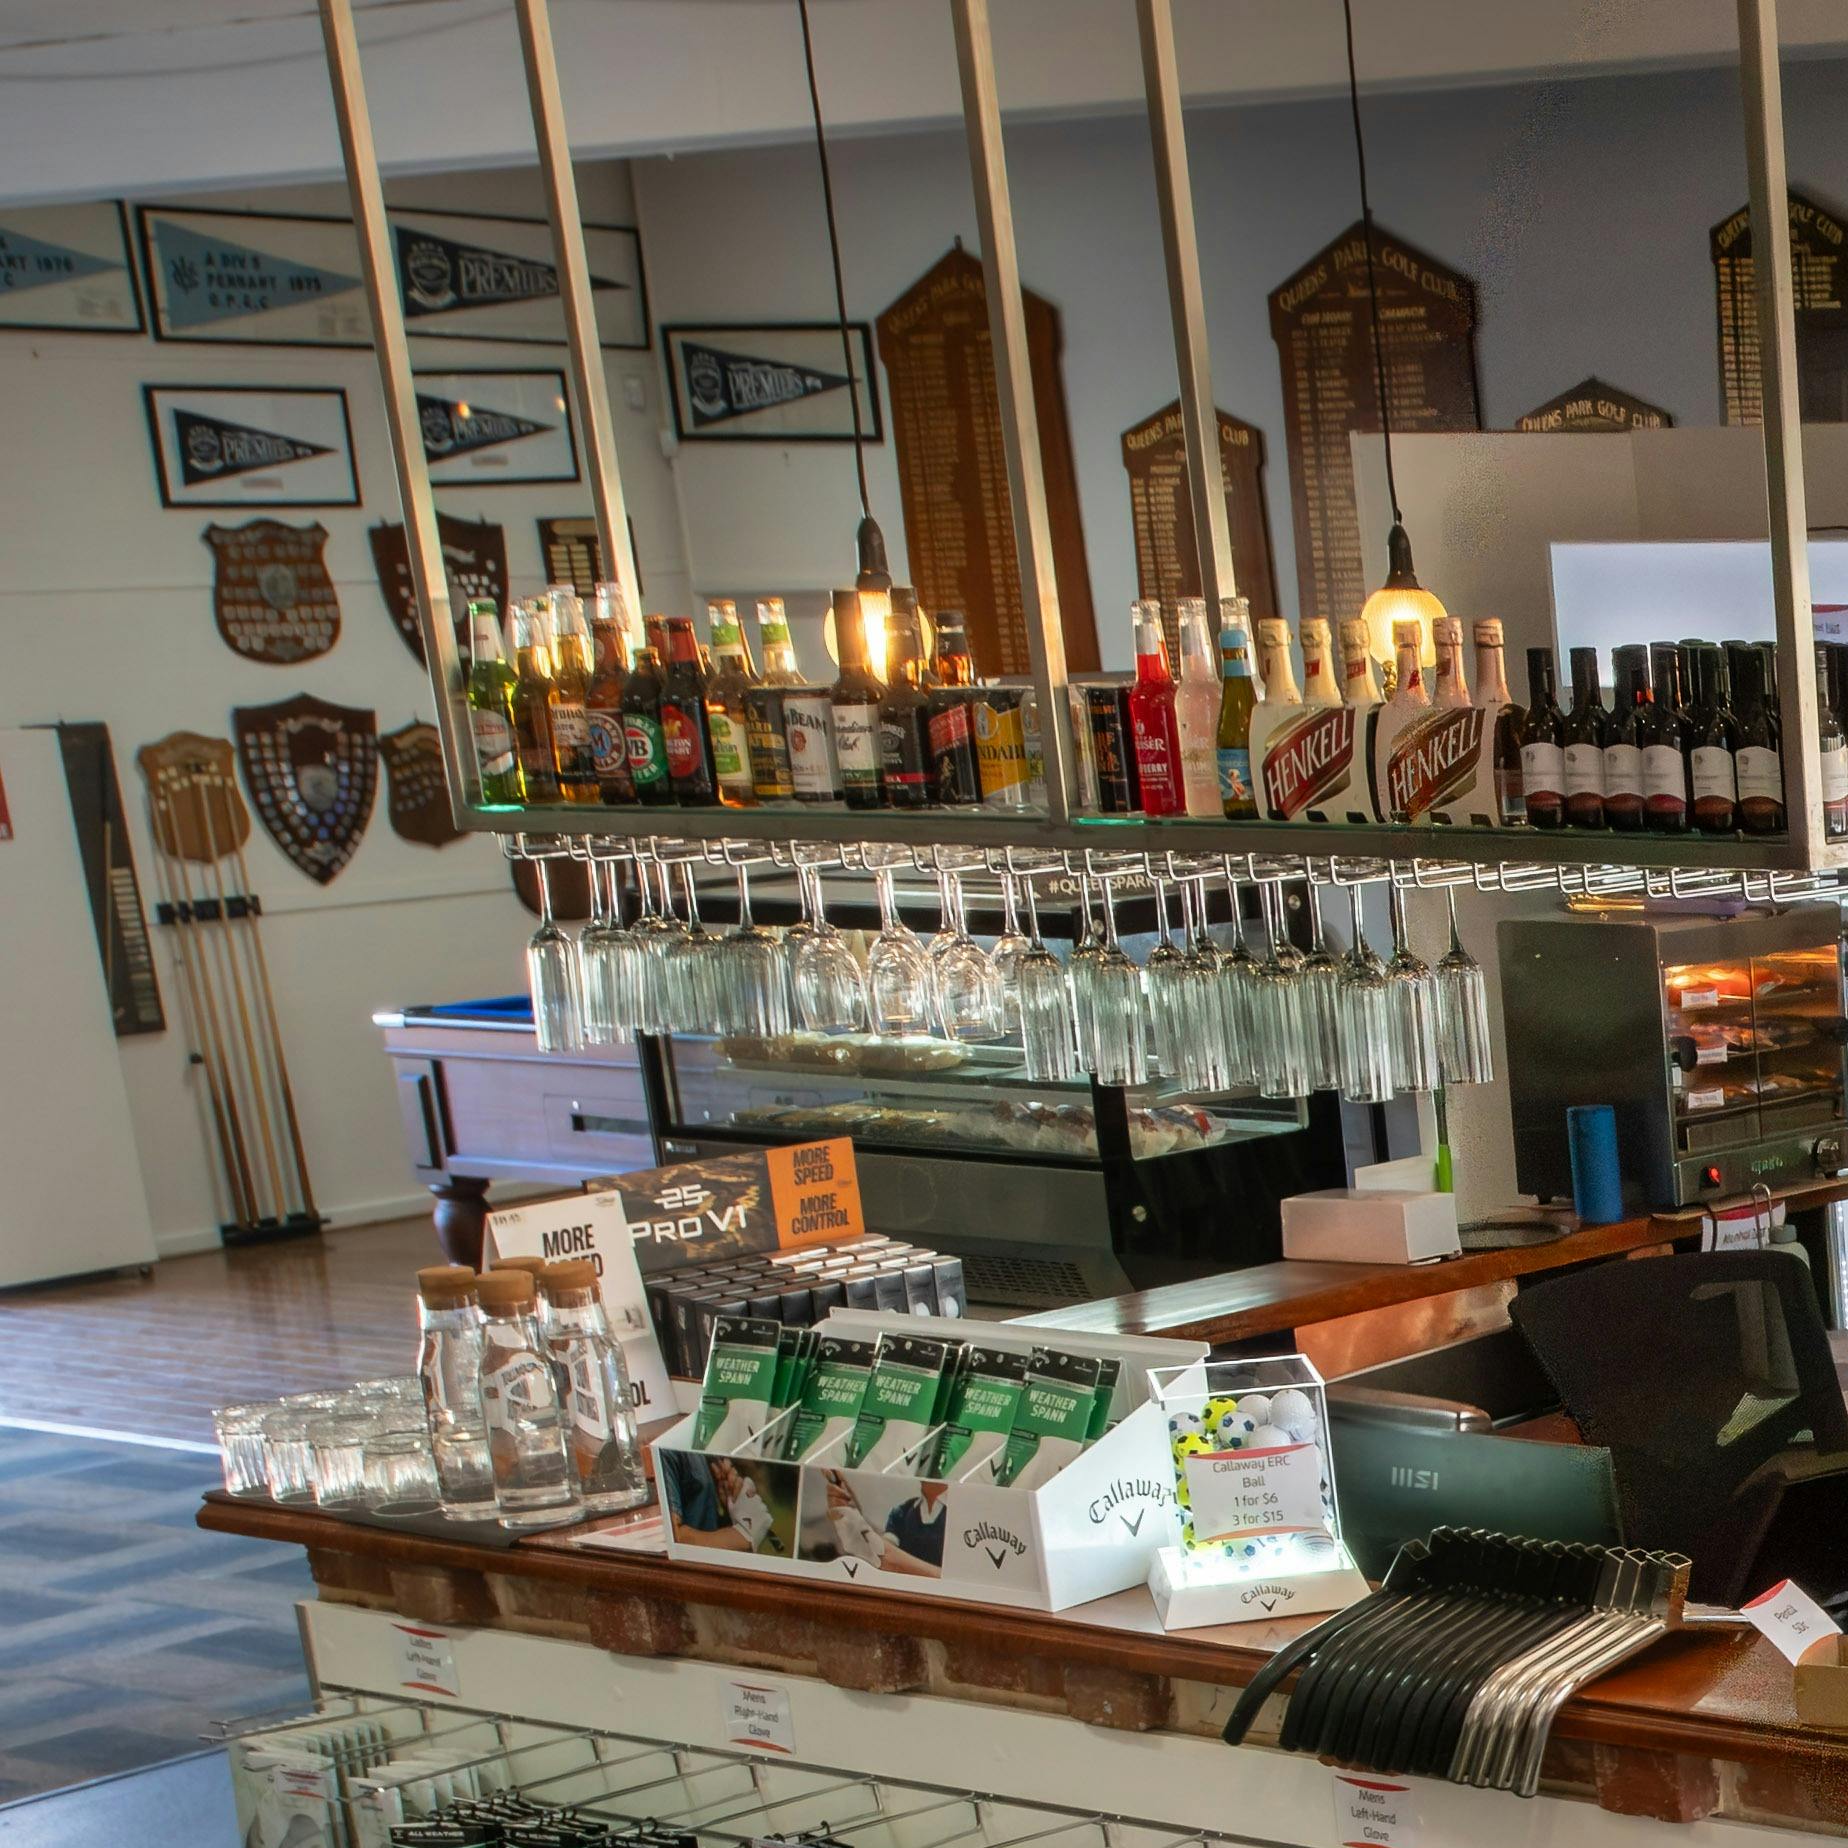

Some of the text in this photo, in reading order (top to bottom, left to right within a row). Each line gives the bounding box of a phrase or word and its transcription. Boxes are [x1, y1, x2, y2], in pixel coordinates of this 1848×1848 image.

[1381, 246, 1418, 283] GOLF
[1421, 271, 1459, 301] CLUB
[1566, 399, 1594, 418] PARK
[1597, 400, 1626, 424] GOLF
[1222, 425, 1249, 446] CLUB
[1266, 706, 1352, 811] HENKELL
[1394, 708, 1482, 812] HENKELL
[792, 1146, 830, 1167] MORE
[793, 1162, 834, 1186] SPEED
[800, 1193, 837, 1214] MORE
[630, 1203, 747, 1248] PRO V1
[791, 1209, 850, 1236] CONTROL
[542, 1224, 594, 1257] MORE
[716, 1356, 761, 1377] WEATHER
[718, 1371, 752, 1386] SPANN
[1028, 1389, 1077, 1409] WEATHER
[1030, 1403, 1067, 1421] SPANN
[1212, 1453, 1292, 1476] Callaway ERC
[1242, 1474, 1267, 1489] Ball
[1090, 1478, 1172, 1526] Callaway
[1233, 1491, 1279, 1508] 1 for $6
[1232, 1509, 1284, 1526] 3 for $15
[963, 1517, 1027, 1557] Callaway
[1241, 1582, 1297, 1606] Callaway
[1358, 1788, 1386, 1806] Mens
[1350, 1807, 1397, 1825] Left-Hand
[1363, 1825, 1390, 1842] Glove
